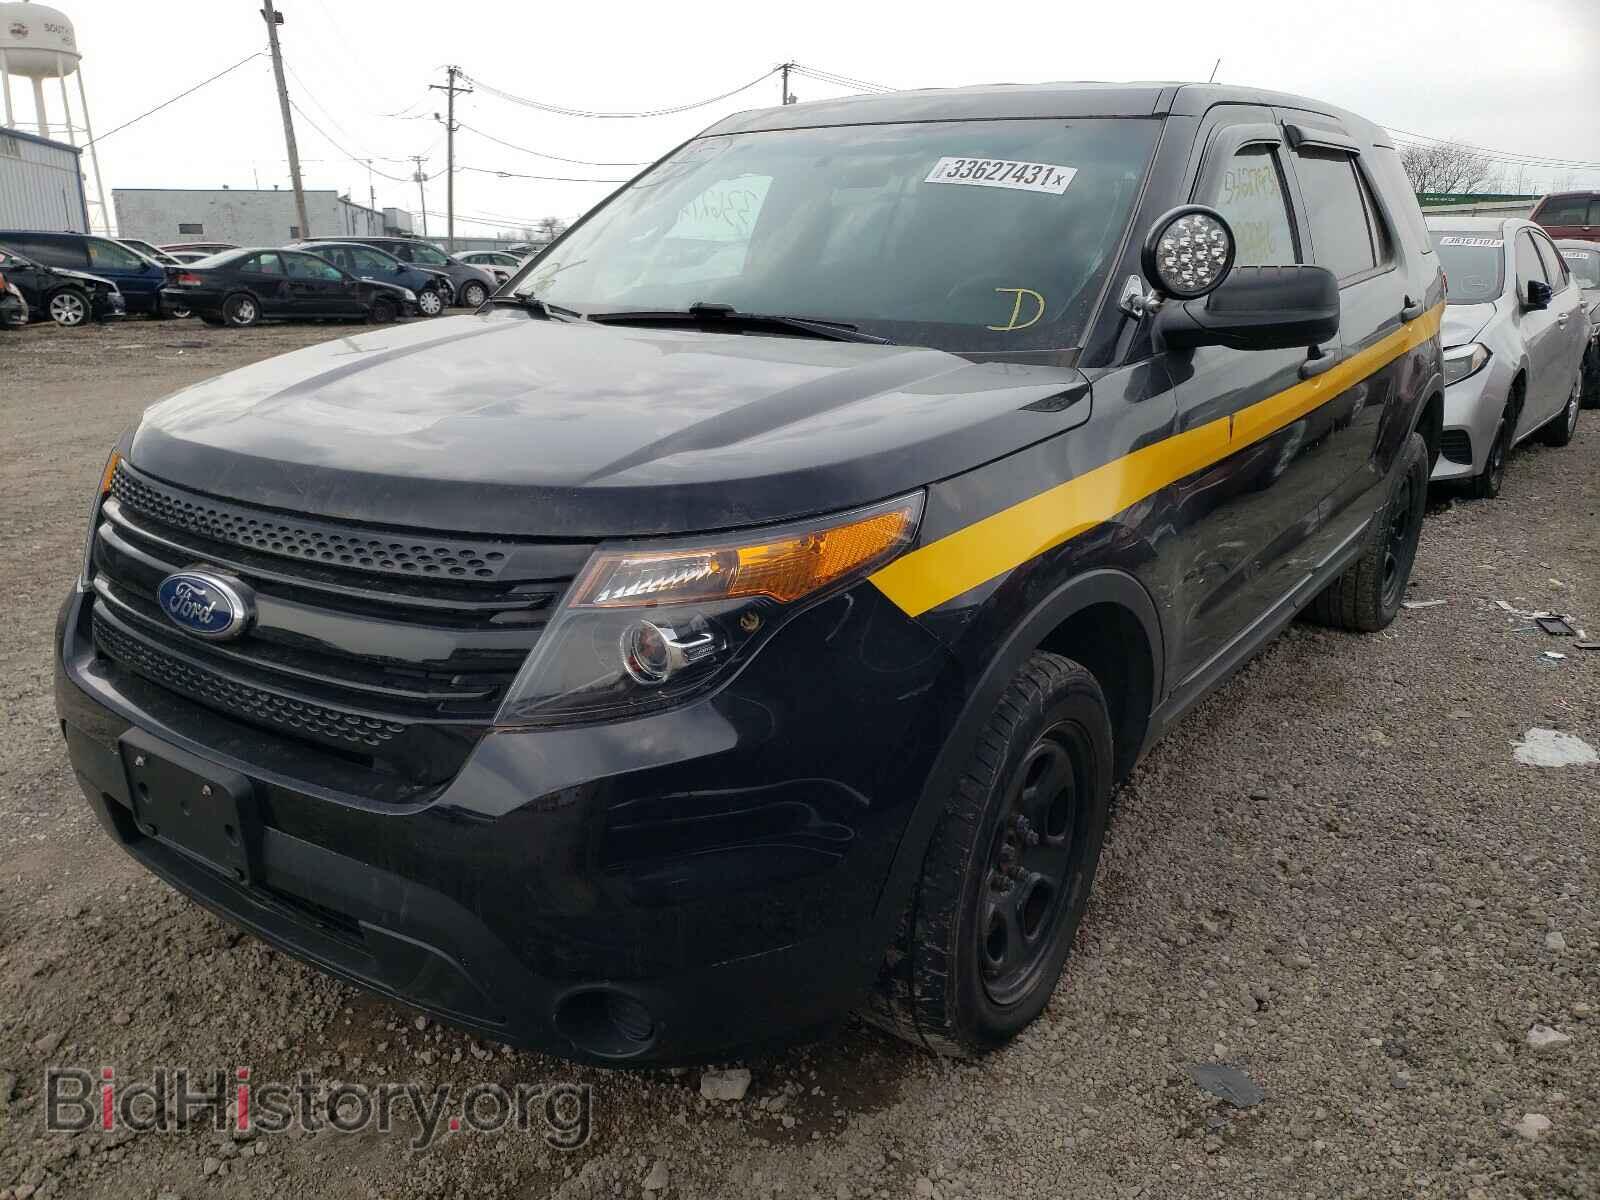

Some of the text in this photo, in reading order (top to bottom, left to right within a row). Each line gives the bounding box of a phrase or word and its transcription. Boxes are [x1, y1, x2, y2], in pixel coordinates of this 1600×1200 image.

[947, 159, 1055, 186] 33627431
[986, 288, 1045, 331] D
[170, 582, 216, 624] Ford
